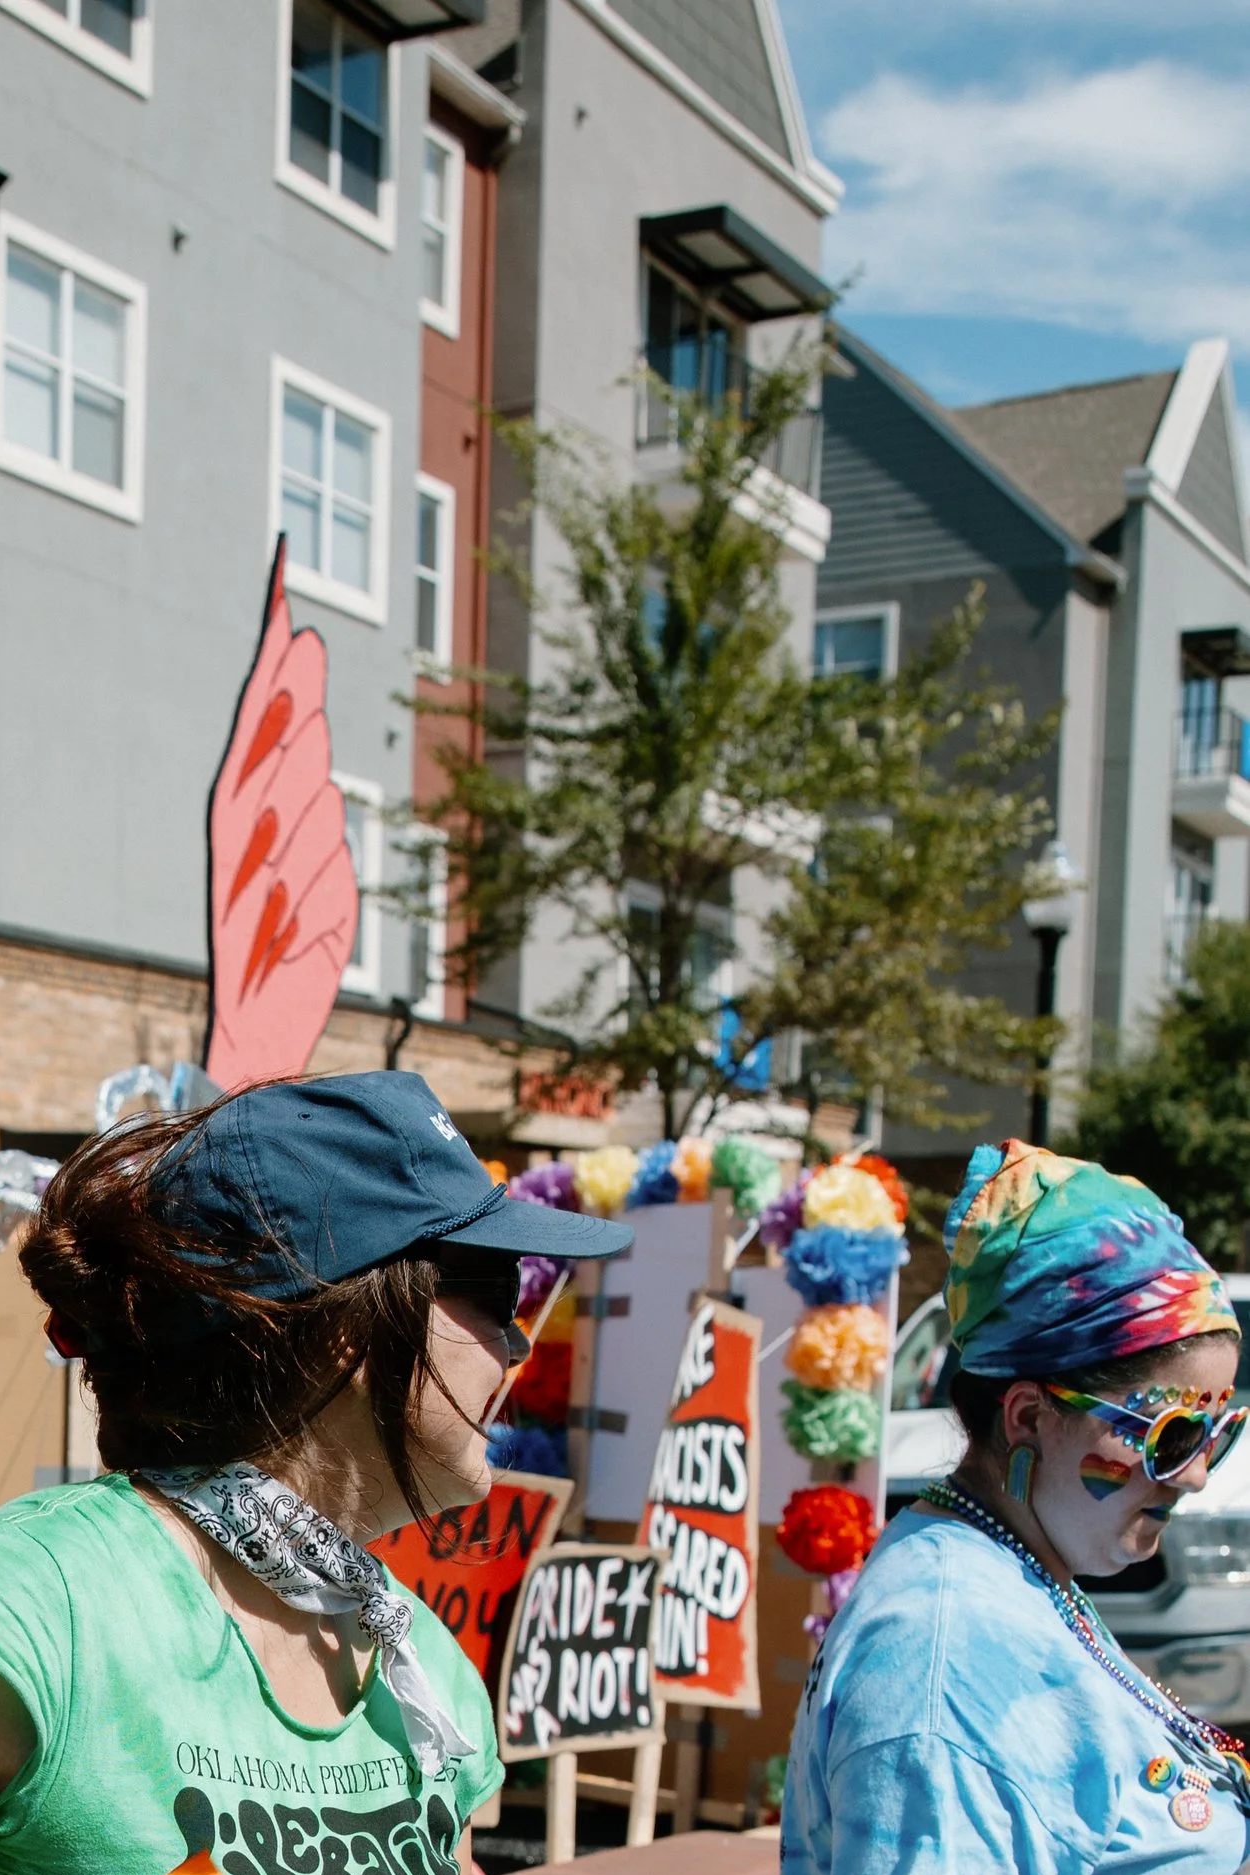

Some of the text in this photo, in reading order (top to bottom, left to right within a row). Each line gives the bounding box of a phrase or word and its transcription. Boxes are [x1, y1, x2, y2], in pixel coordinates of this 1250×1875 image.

[517, 1557, 624, 1654] PRIDE
[557, 1647, 651, 1727] RIOT!
[176, 1740, 314, 1795] OKLAHOMA
